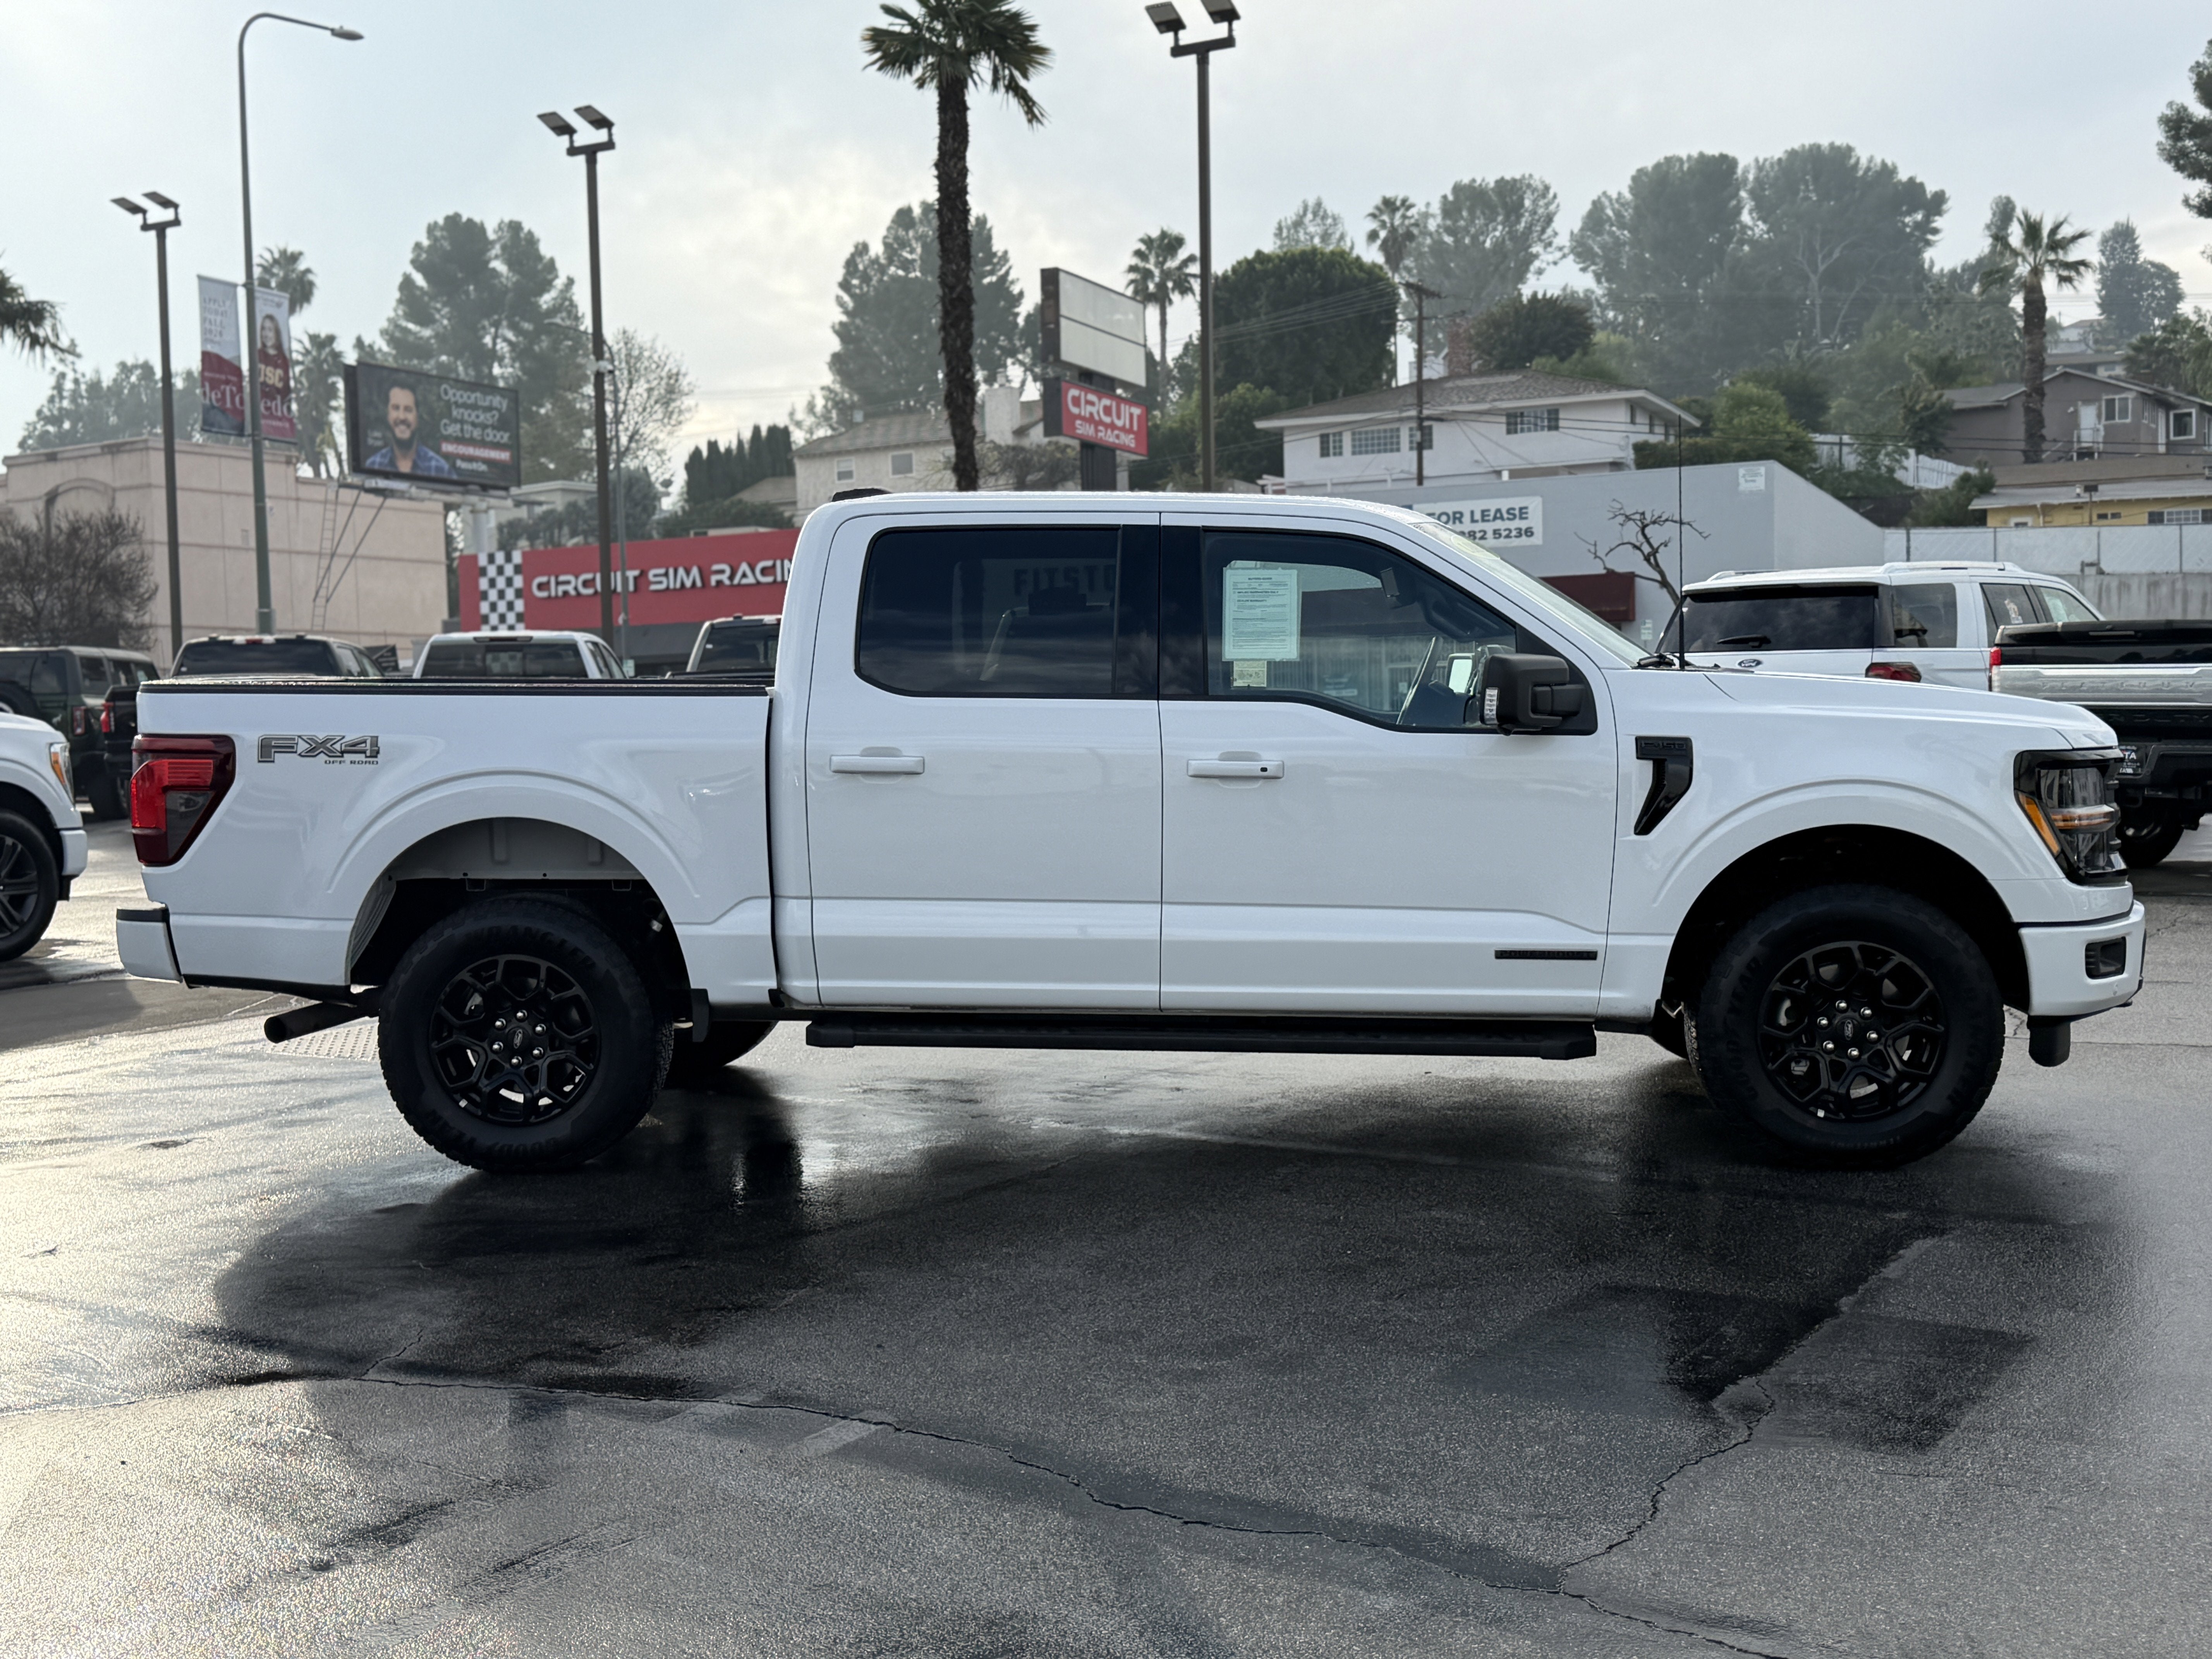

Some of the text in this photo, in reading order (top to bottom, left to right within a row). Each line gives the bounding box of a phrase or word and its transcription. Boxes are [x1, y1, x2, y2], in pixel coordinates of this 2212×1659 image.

[440, 384, 508, 413] Opportunity
[1067, 388, 1141, 431] CIRCUIT
[452, 405, 499, 425] knocks?
[440, 419, 462, 437] Get
[464, 423, 482, 440] the
[1075, 419, 1135, 448] SIM RACING
[1470, 507, 1529, 523] LEASE
[1492, 527, 1534, 539] 5236
[648, 565, 702, 591] SIM
[258, 734, 380, 763] FX4
